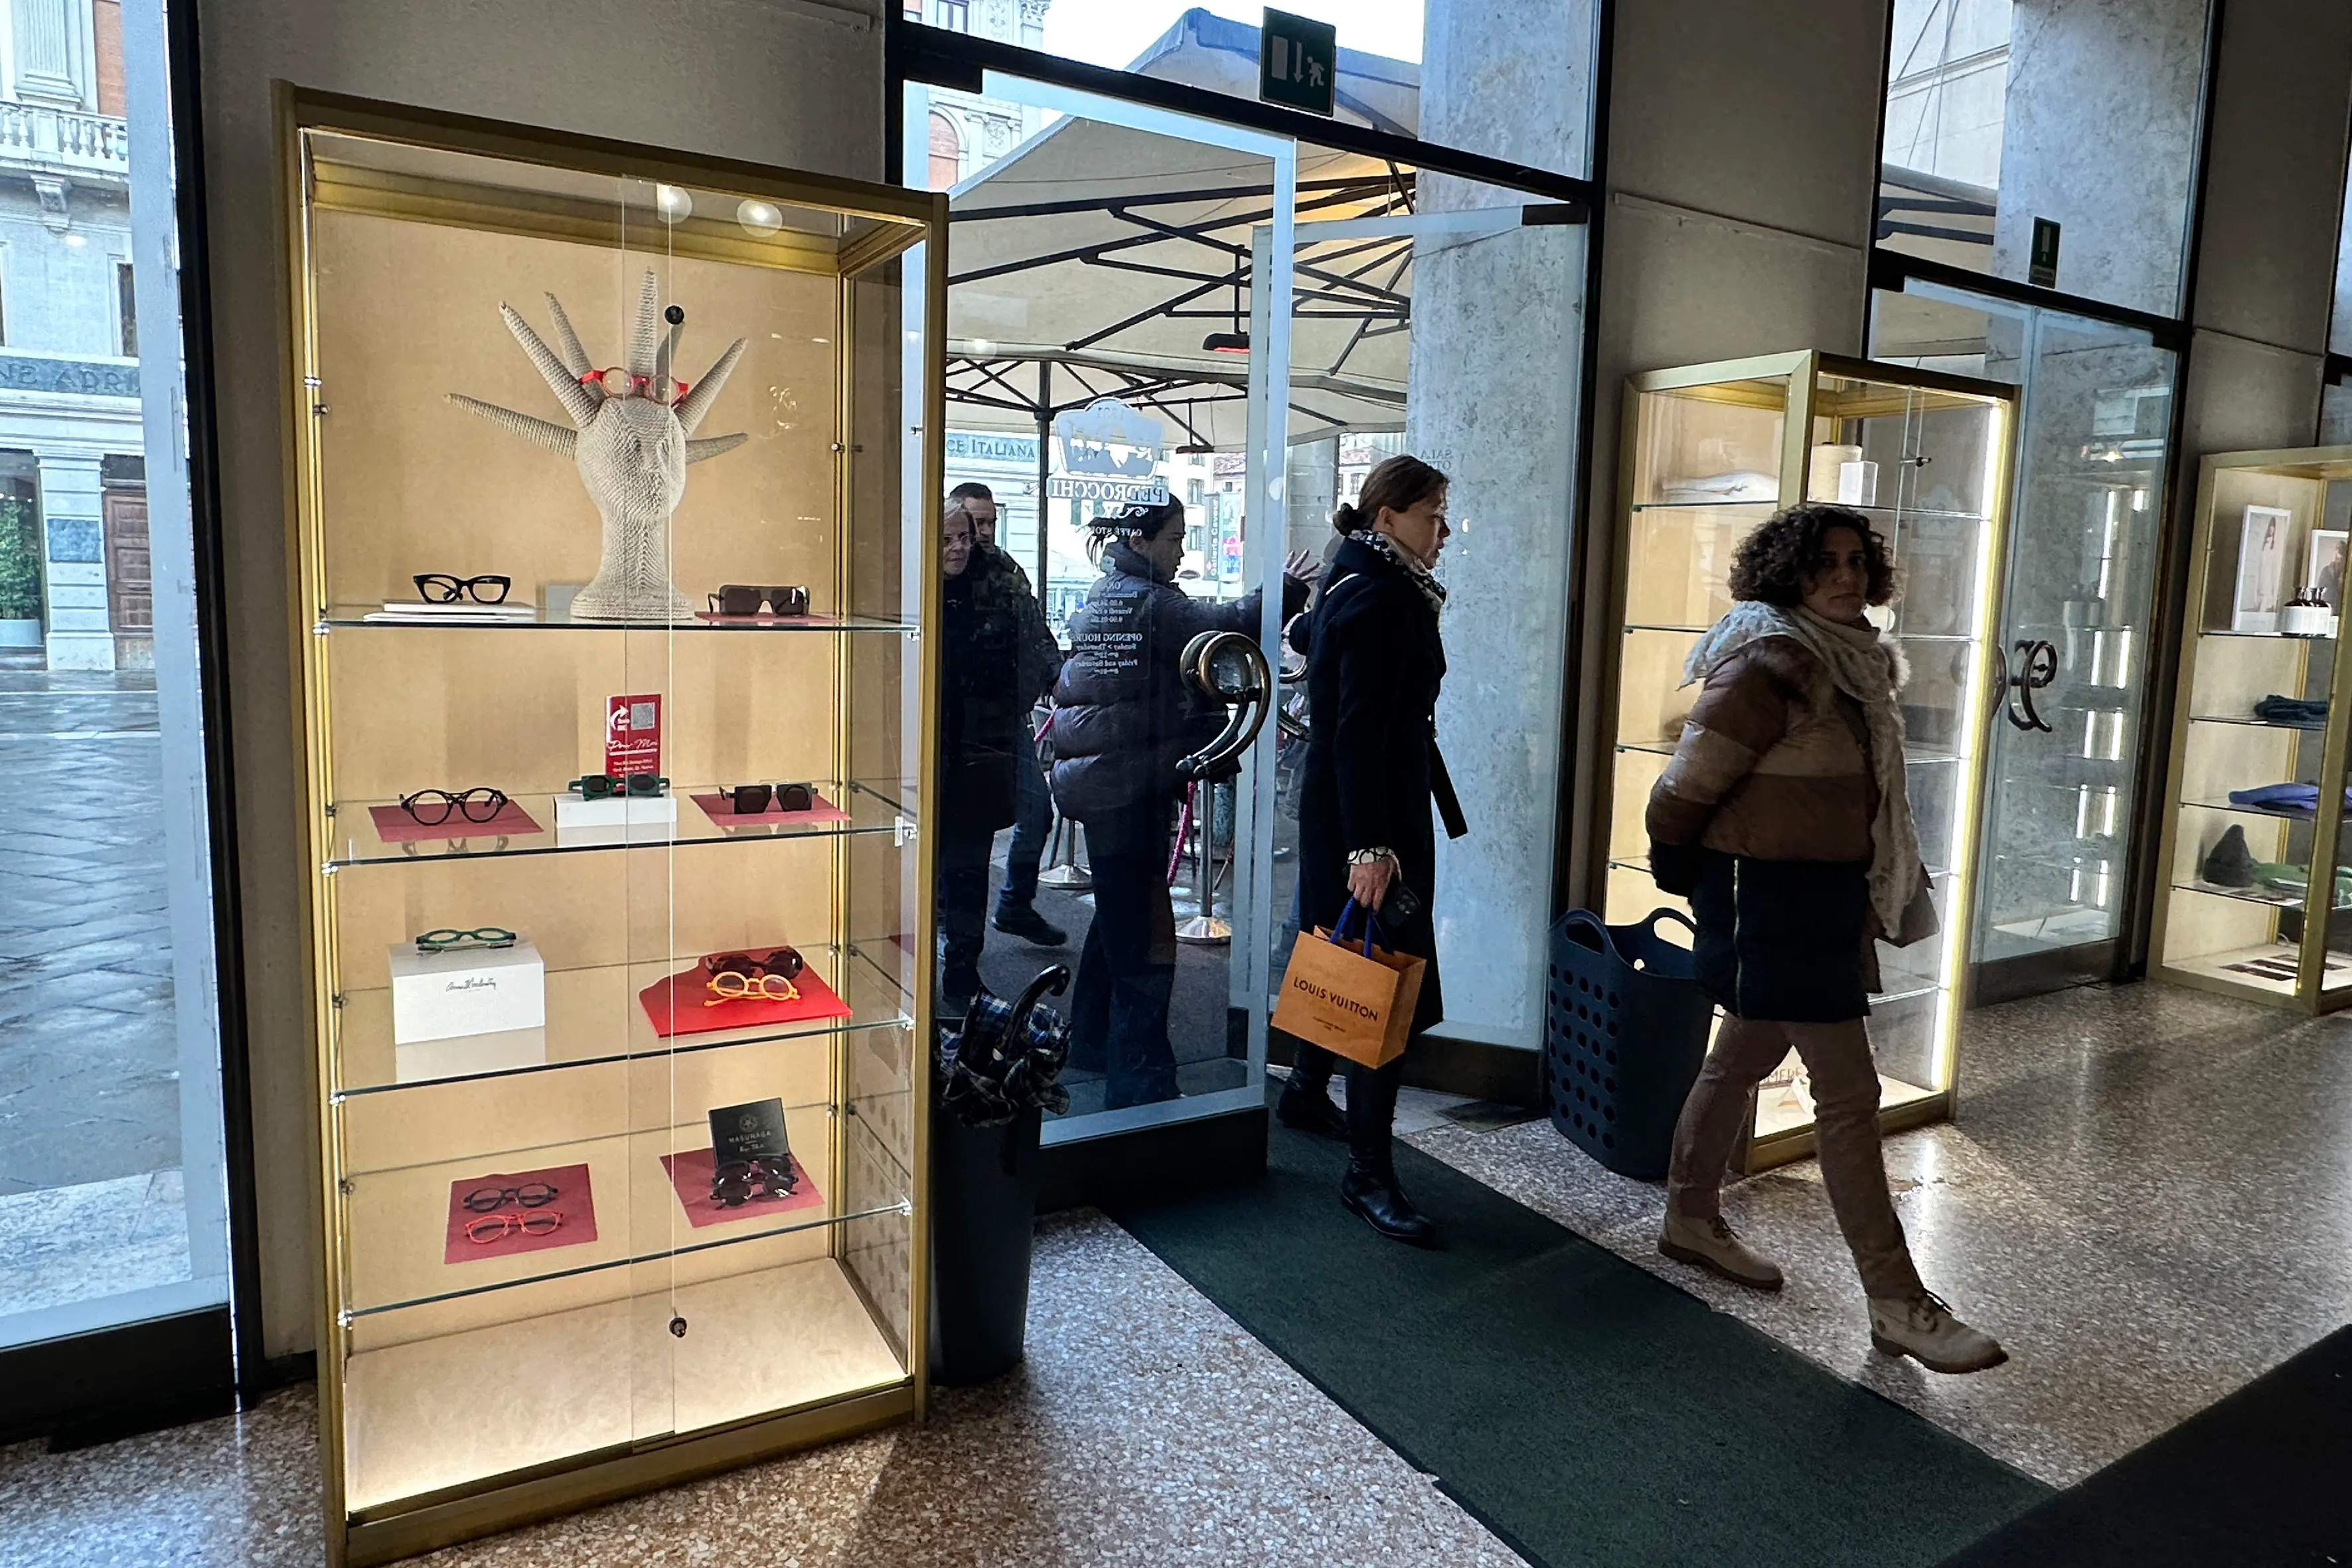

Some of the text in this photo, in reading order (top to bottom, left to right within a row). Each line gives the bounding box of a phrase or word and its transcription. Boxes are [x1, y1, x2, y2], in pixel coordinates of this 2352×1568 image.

[54, 369, 140, 393] ADRI
[1293, 977, 1379, 1022] LOUIS VUITTON
